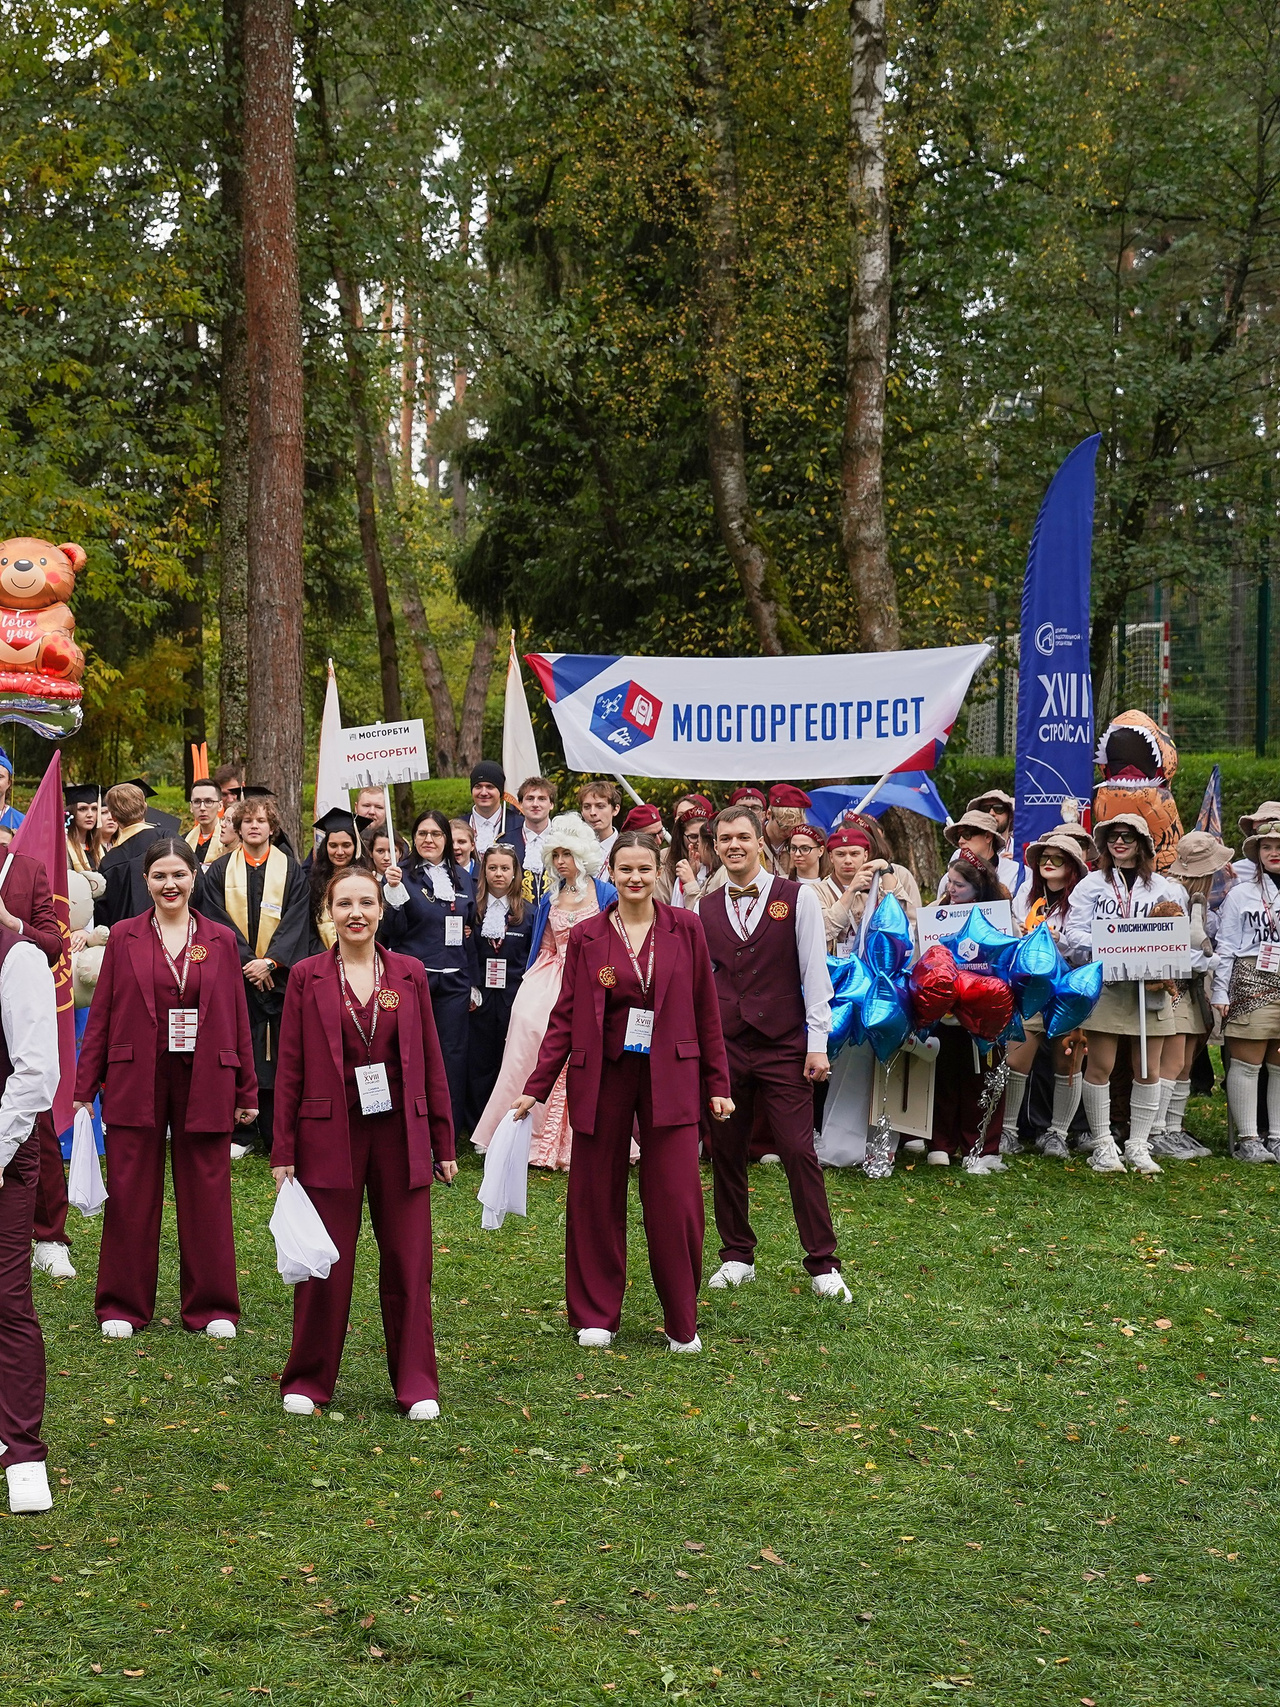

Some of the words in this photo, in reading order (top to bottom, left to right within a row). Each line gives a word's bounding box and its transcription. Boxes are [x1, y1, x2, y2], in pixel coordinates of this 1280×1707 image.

[1, 615, 36, 628] love
[5, 629, 37, 644] you
[673, 697, 924, 742] МОСГОРГЕОТРЕСТ
[359, 726, 410, 740] МОСГОРБТИ
[347, 746, 417, 762] МОСГОРБТИ
[1118, 922, 1174, 933] МОСИНЖПРОЕКТ
[1098, 944, 1187, 954] МОСИНЖПРОЕКТ
